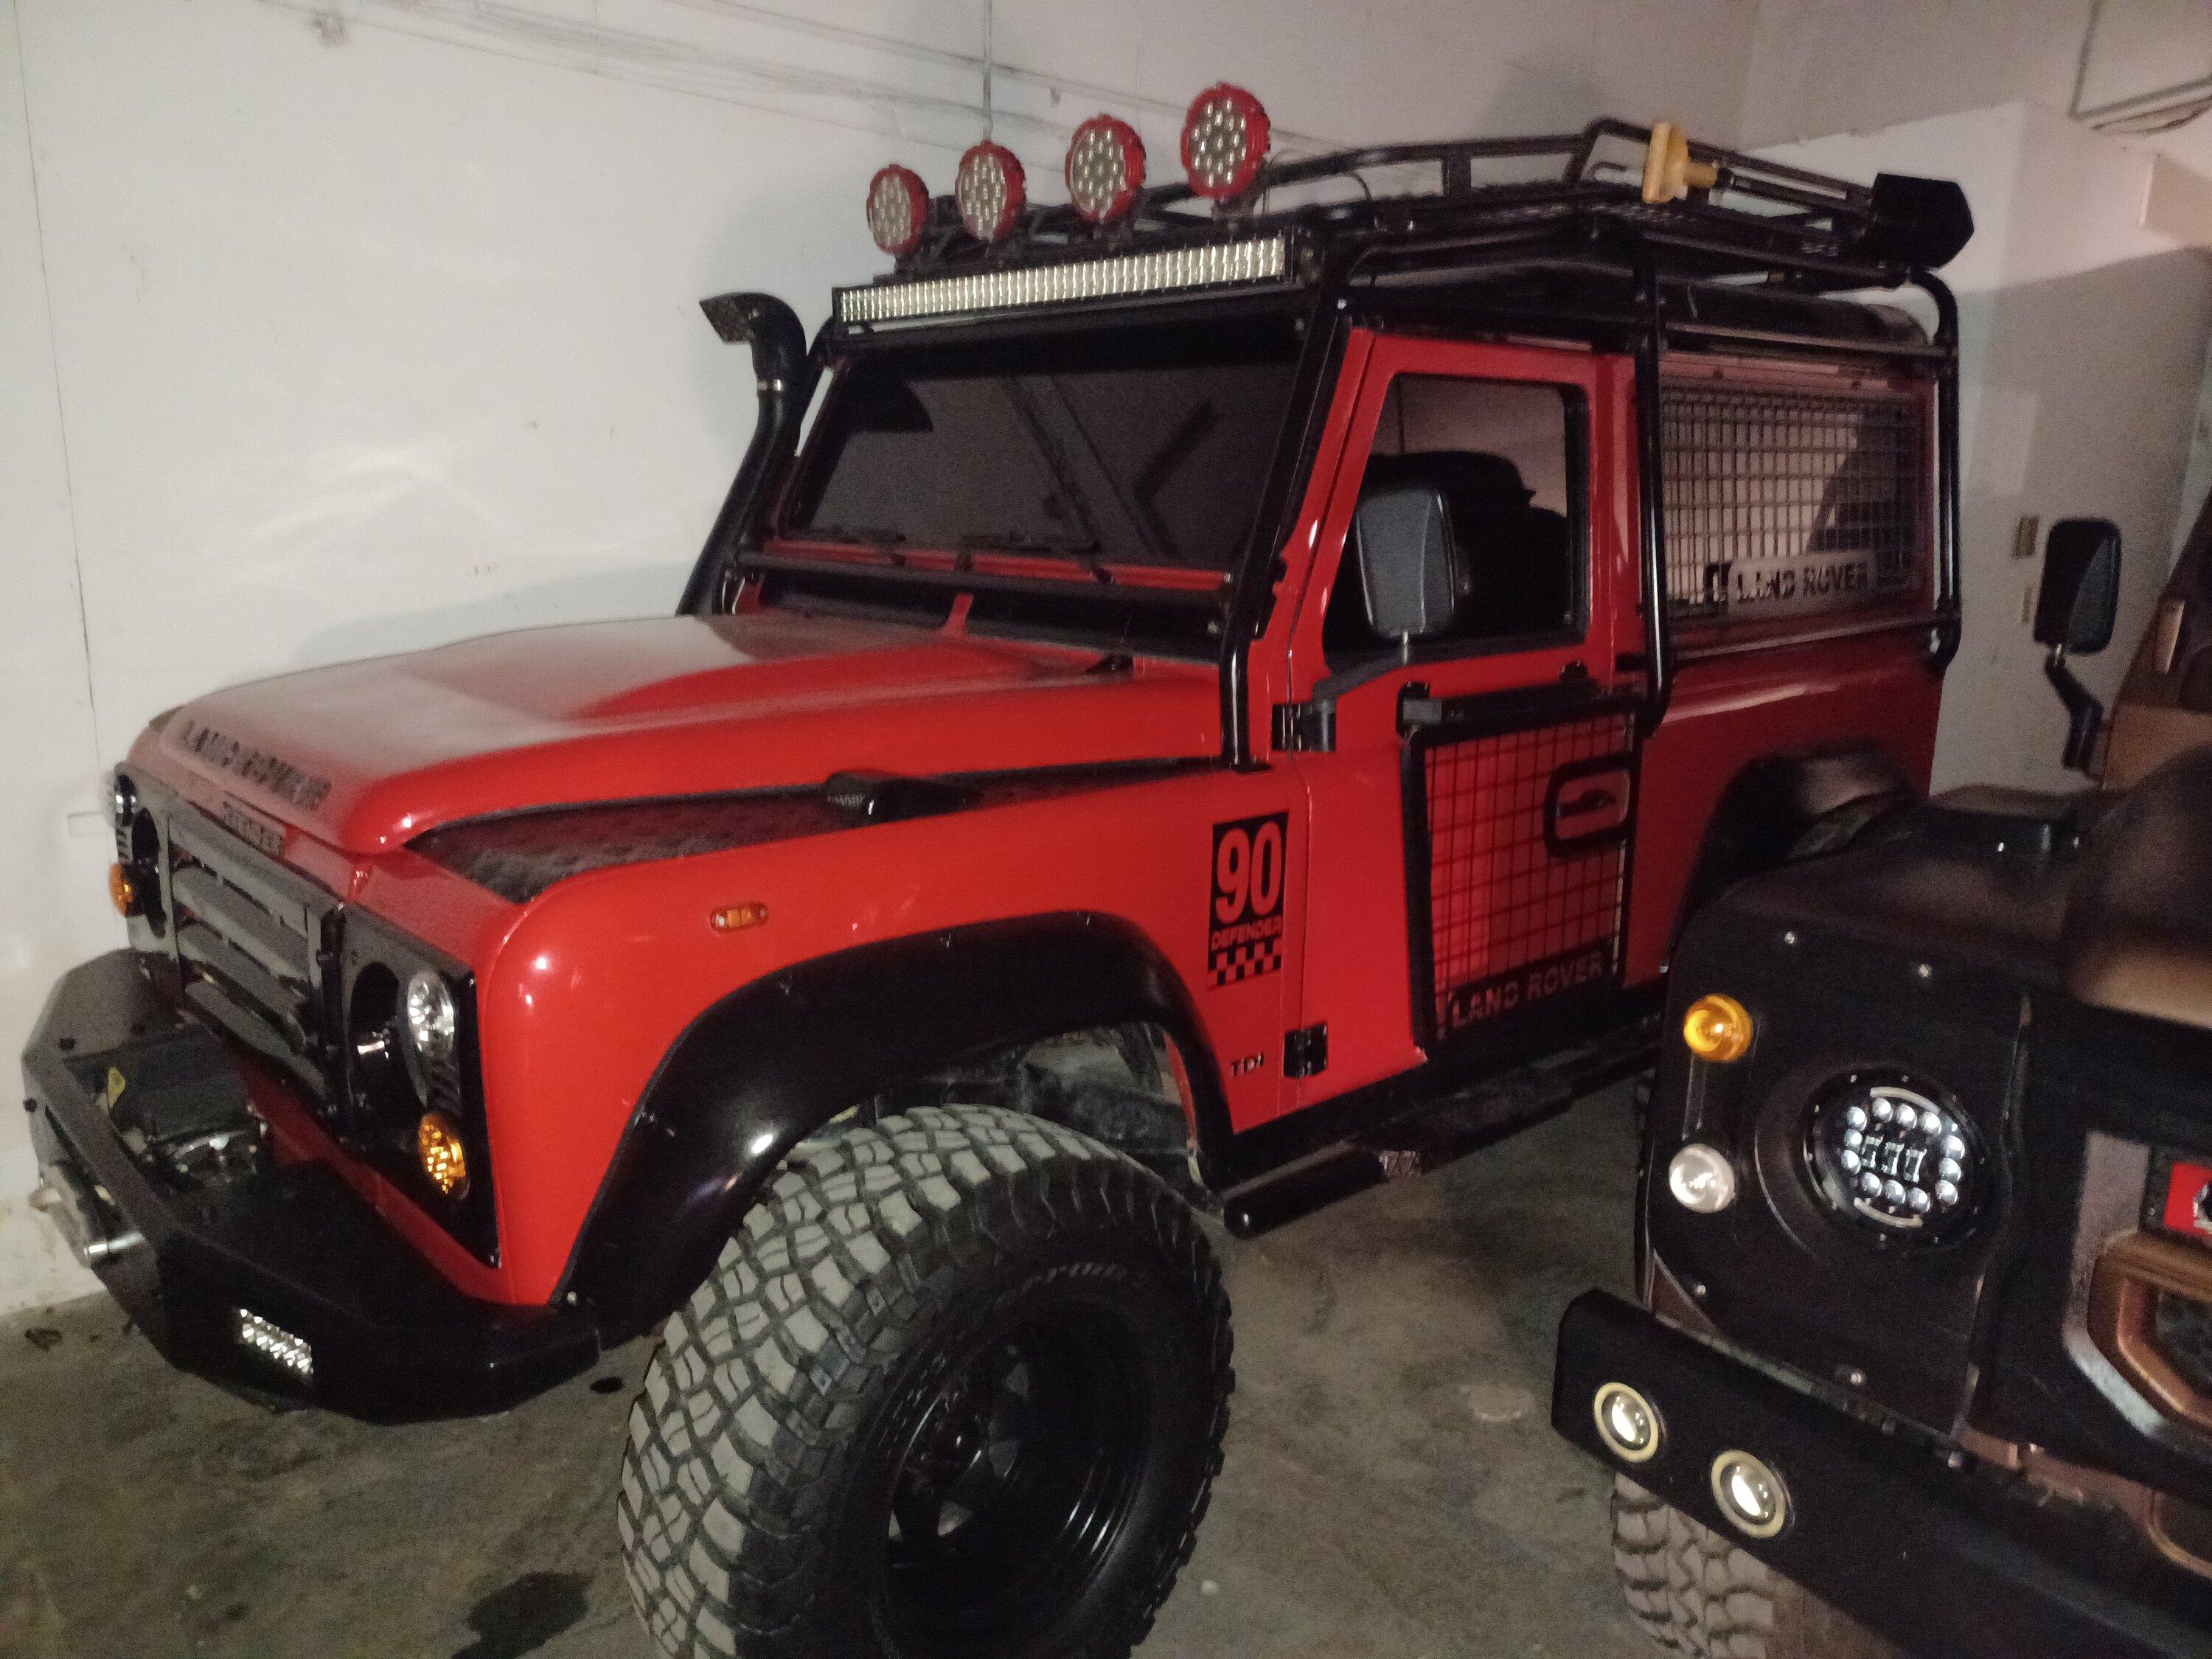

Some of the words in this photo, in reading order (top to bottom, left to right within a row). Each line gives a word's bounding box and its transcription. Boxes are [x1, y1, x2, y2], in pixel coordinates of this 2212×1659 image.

[1215, 820, 1282, 925] 90
[1211, 916, 1282, 951] DEFENDER
[1452, 981, 1519, 1029] LAND
[1527, 951, 1602, 1001] ROVER
